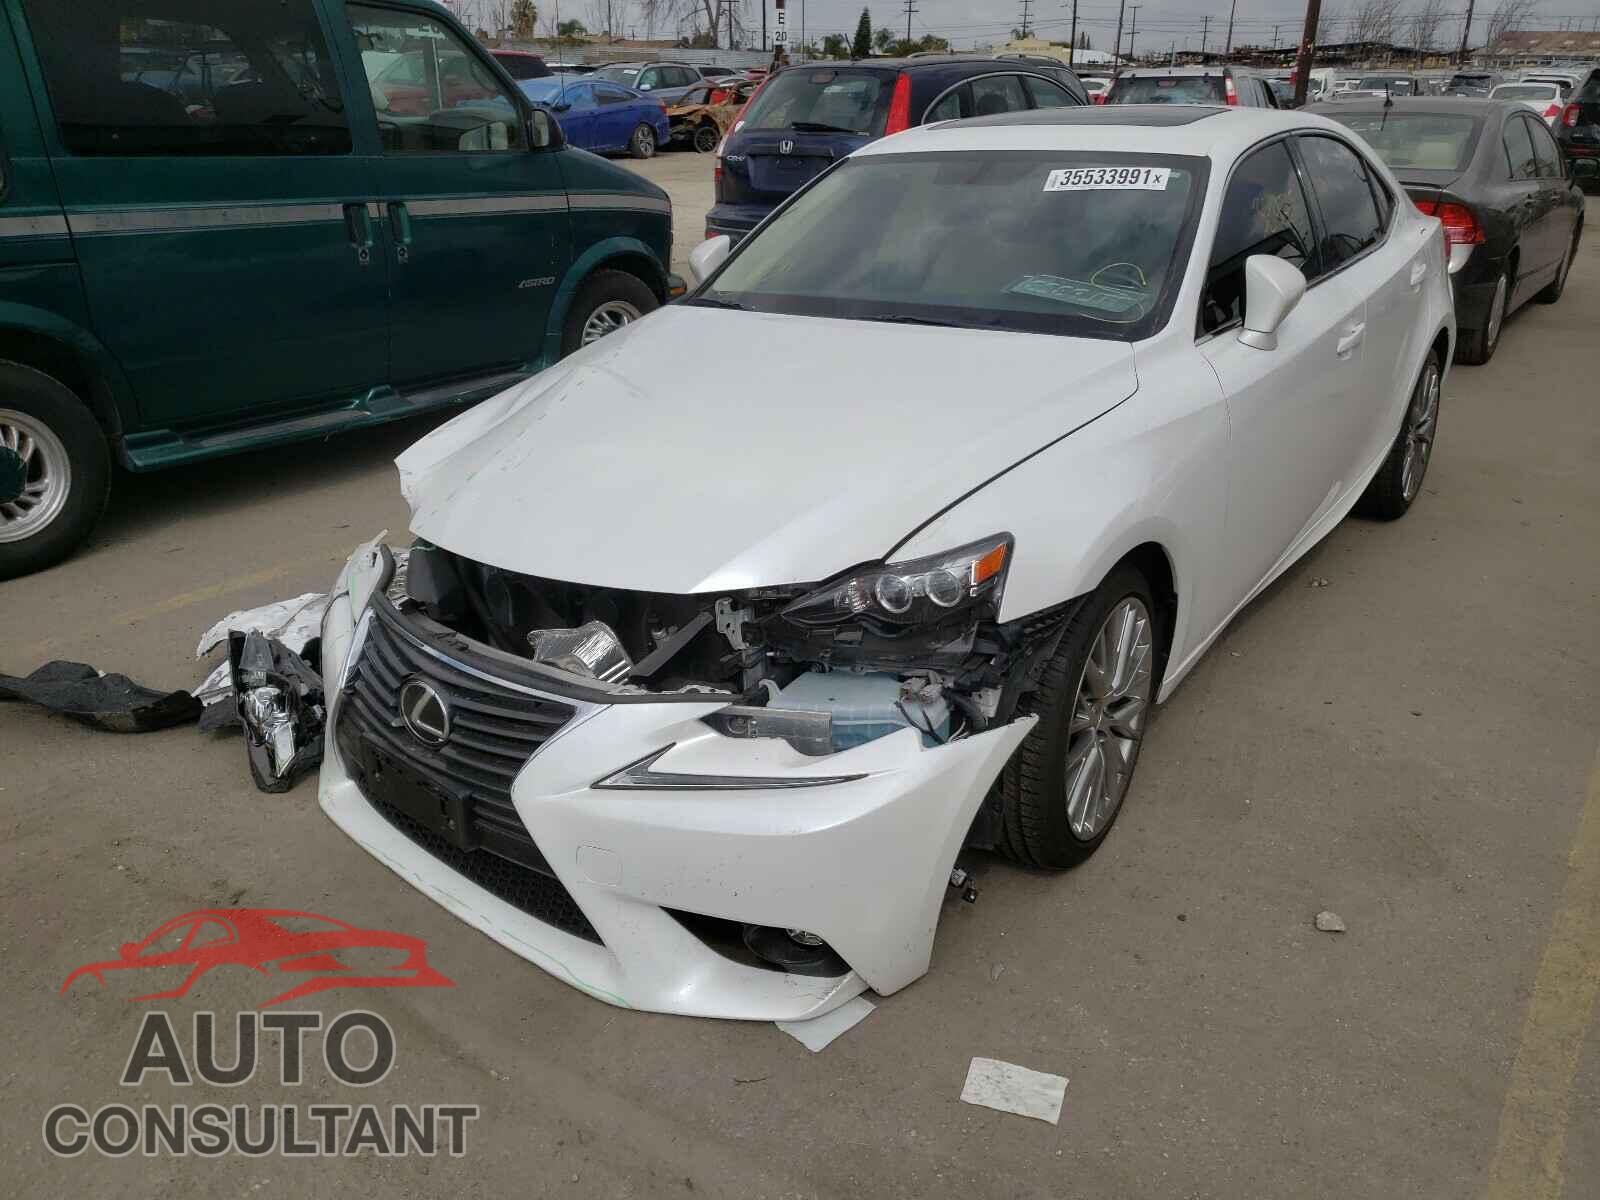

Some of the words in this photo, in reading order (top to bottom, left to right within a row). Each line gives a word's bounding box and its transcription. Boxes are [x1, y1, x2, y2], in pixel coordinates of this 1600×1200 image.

[778, 12, 785, 24] E
[775, 31, 787, 41] 20
[1060, 168, 1152, 186] 35533991
